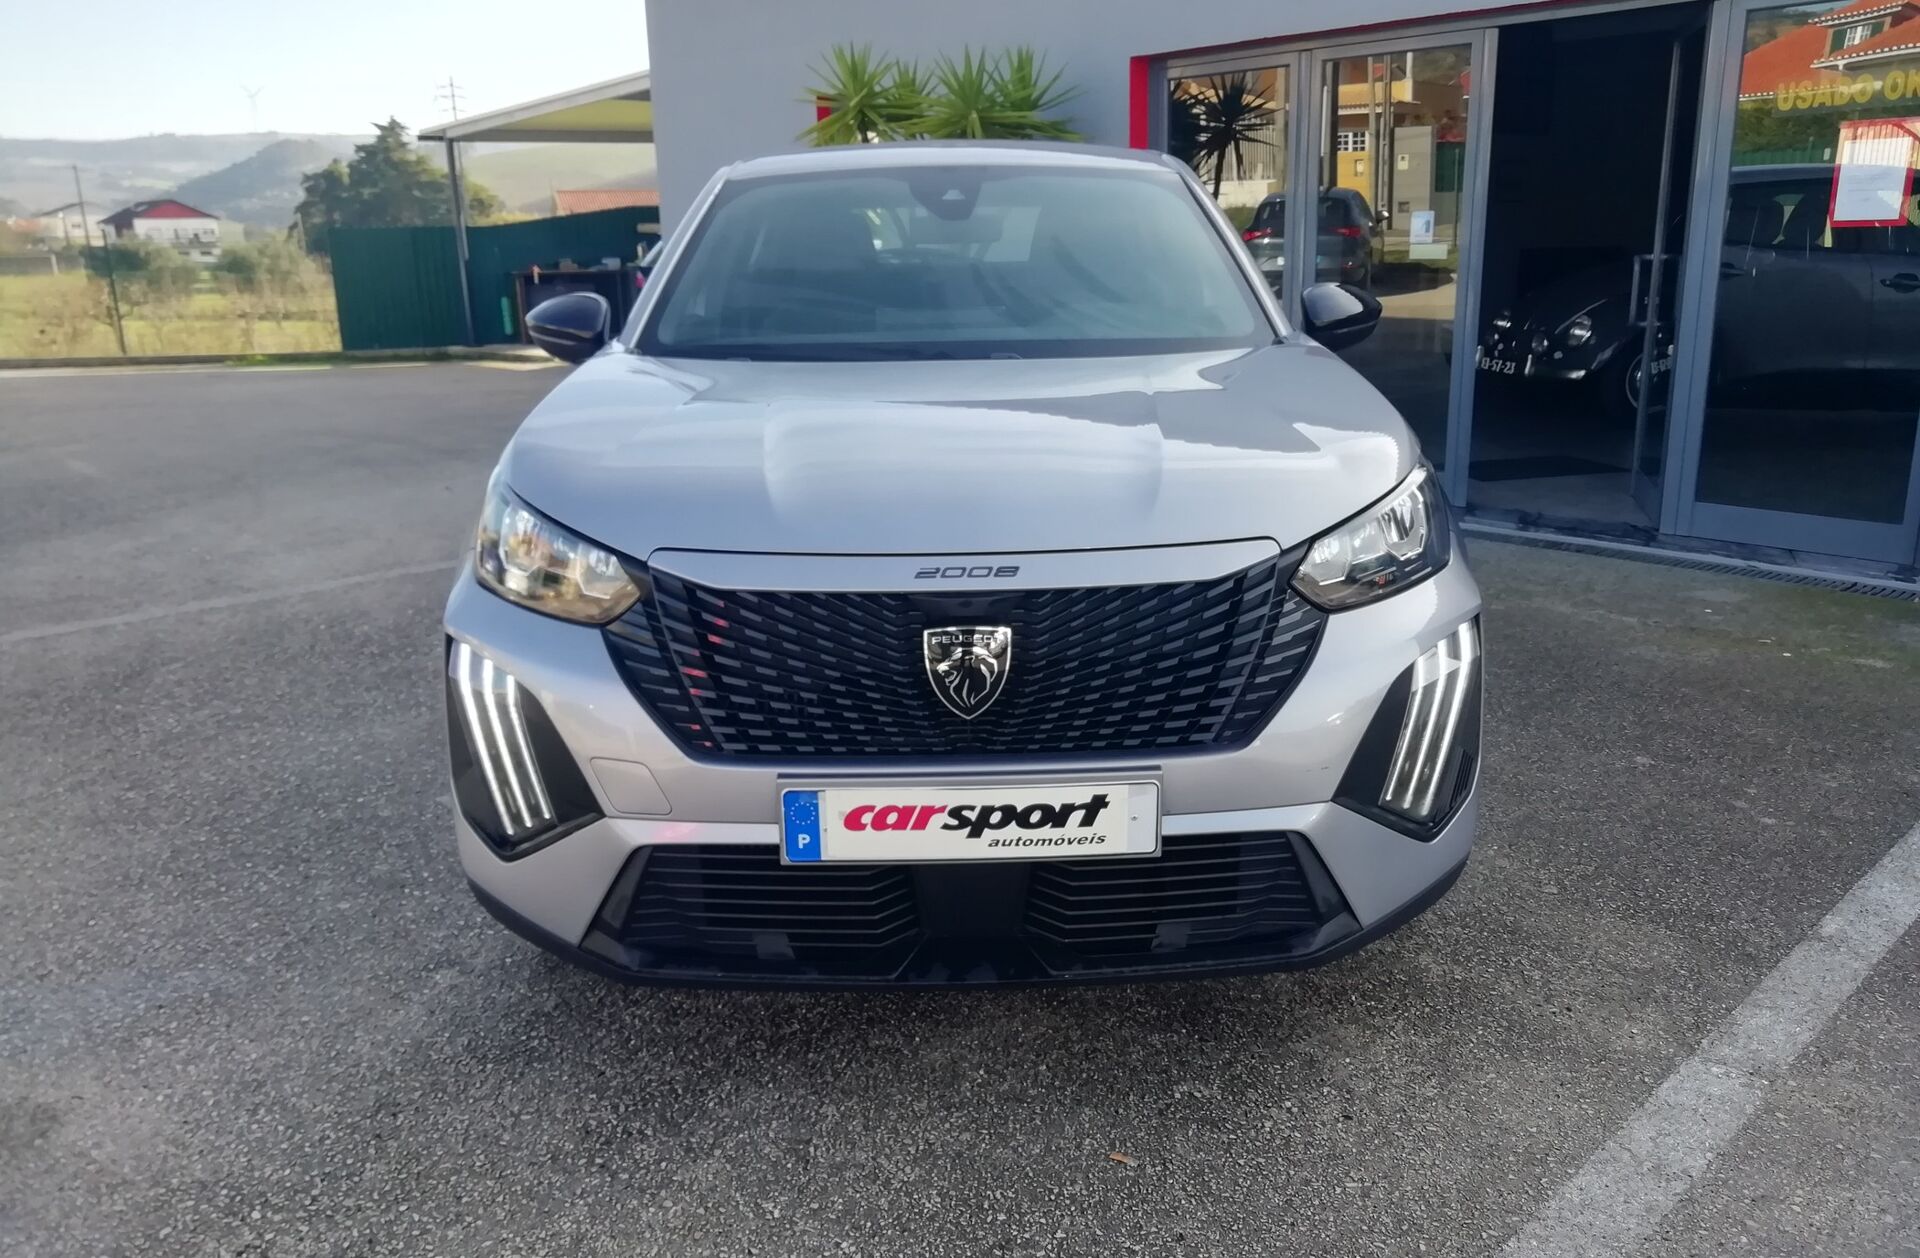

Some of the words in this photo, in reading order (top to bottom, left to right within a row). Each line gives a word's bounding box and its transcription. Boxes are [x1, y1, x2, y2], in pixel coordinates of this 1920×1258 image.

[1777, 74, 1875, 111] USADO
[914, 566, 1020, 579] 2008
[931, 634, 1002, 645] PEUGEOT
[797, 834, 811, 849] P
[987, 832, 1107, 848] automóveis
